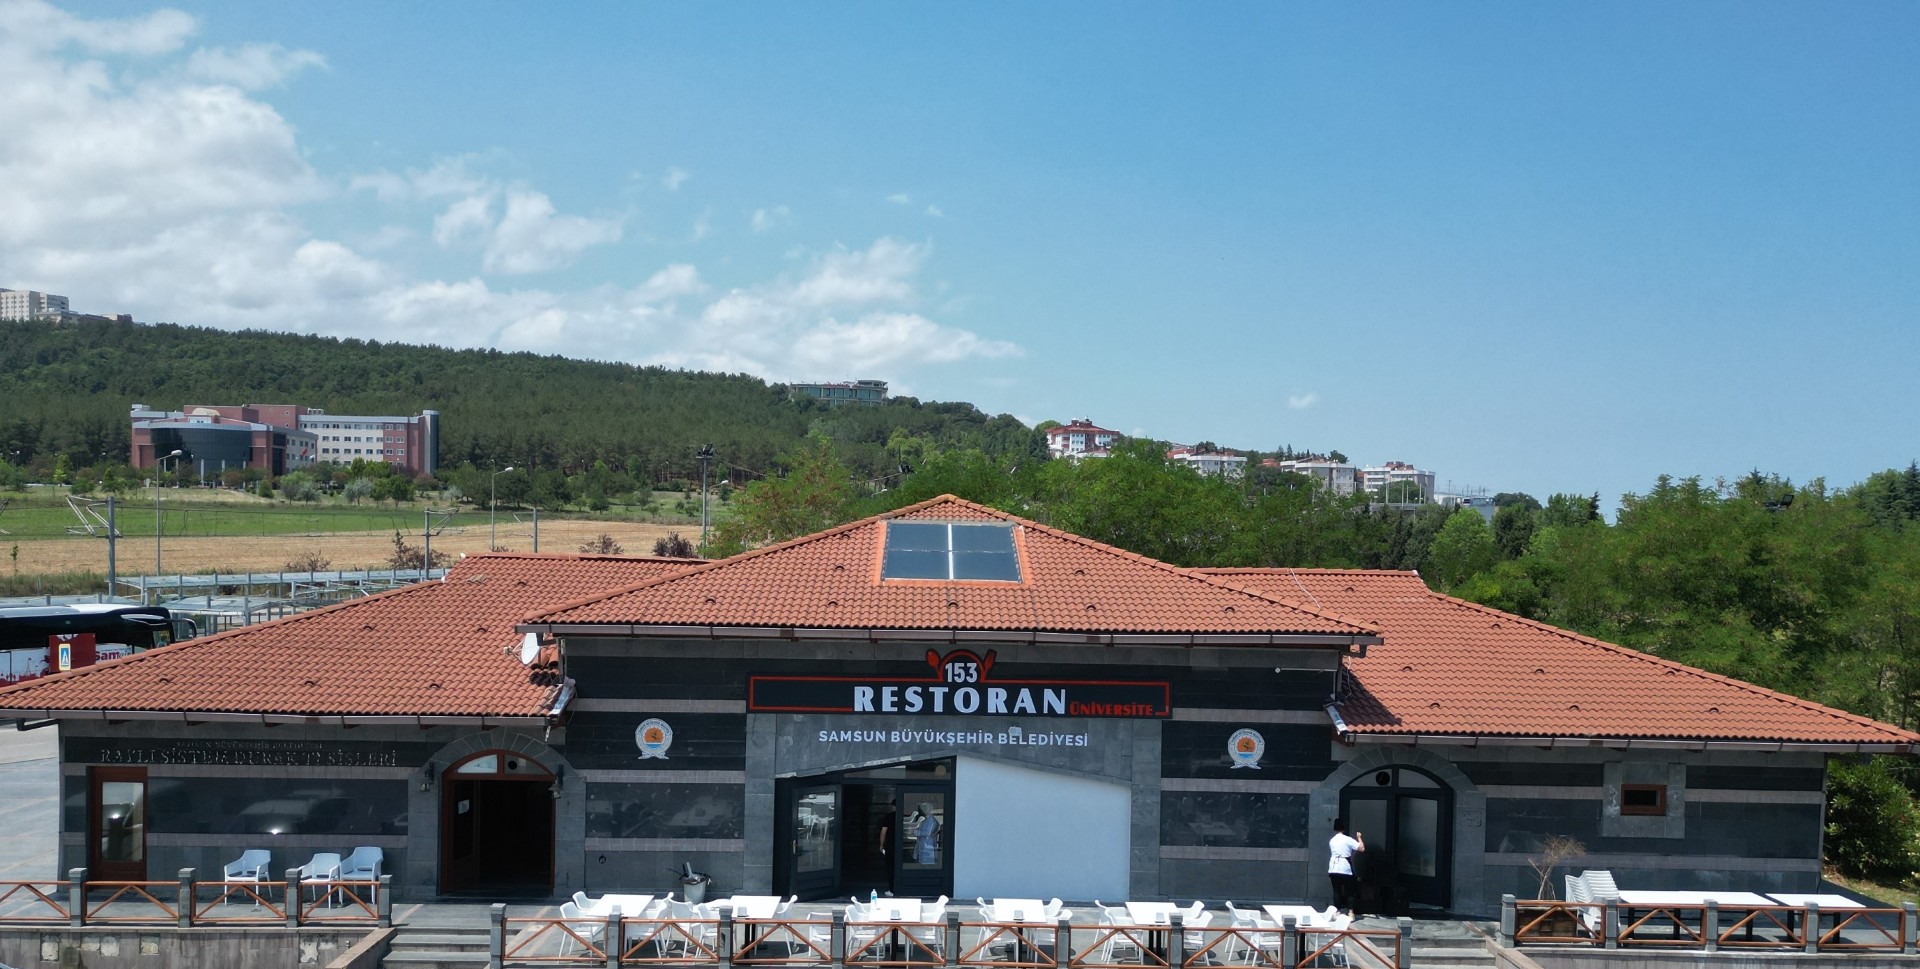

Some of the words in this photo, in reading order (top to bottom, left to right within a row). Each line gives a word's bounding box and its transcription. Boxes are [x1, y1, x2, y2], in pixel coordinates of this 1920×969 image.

[945, 662, 978, 683] 153
[854, 686, 1066, 715] RESTORAN
[1069, 701, 1153, 716] ÜNİVERSİTE
[818, 730, 886, 743] SAMSUN
[890, 729, 993, 747] BÜYÜKŞEHİR
[998, 731, 1088, 747] BELEDİYESİ
